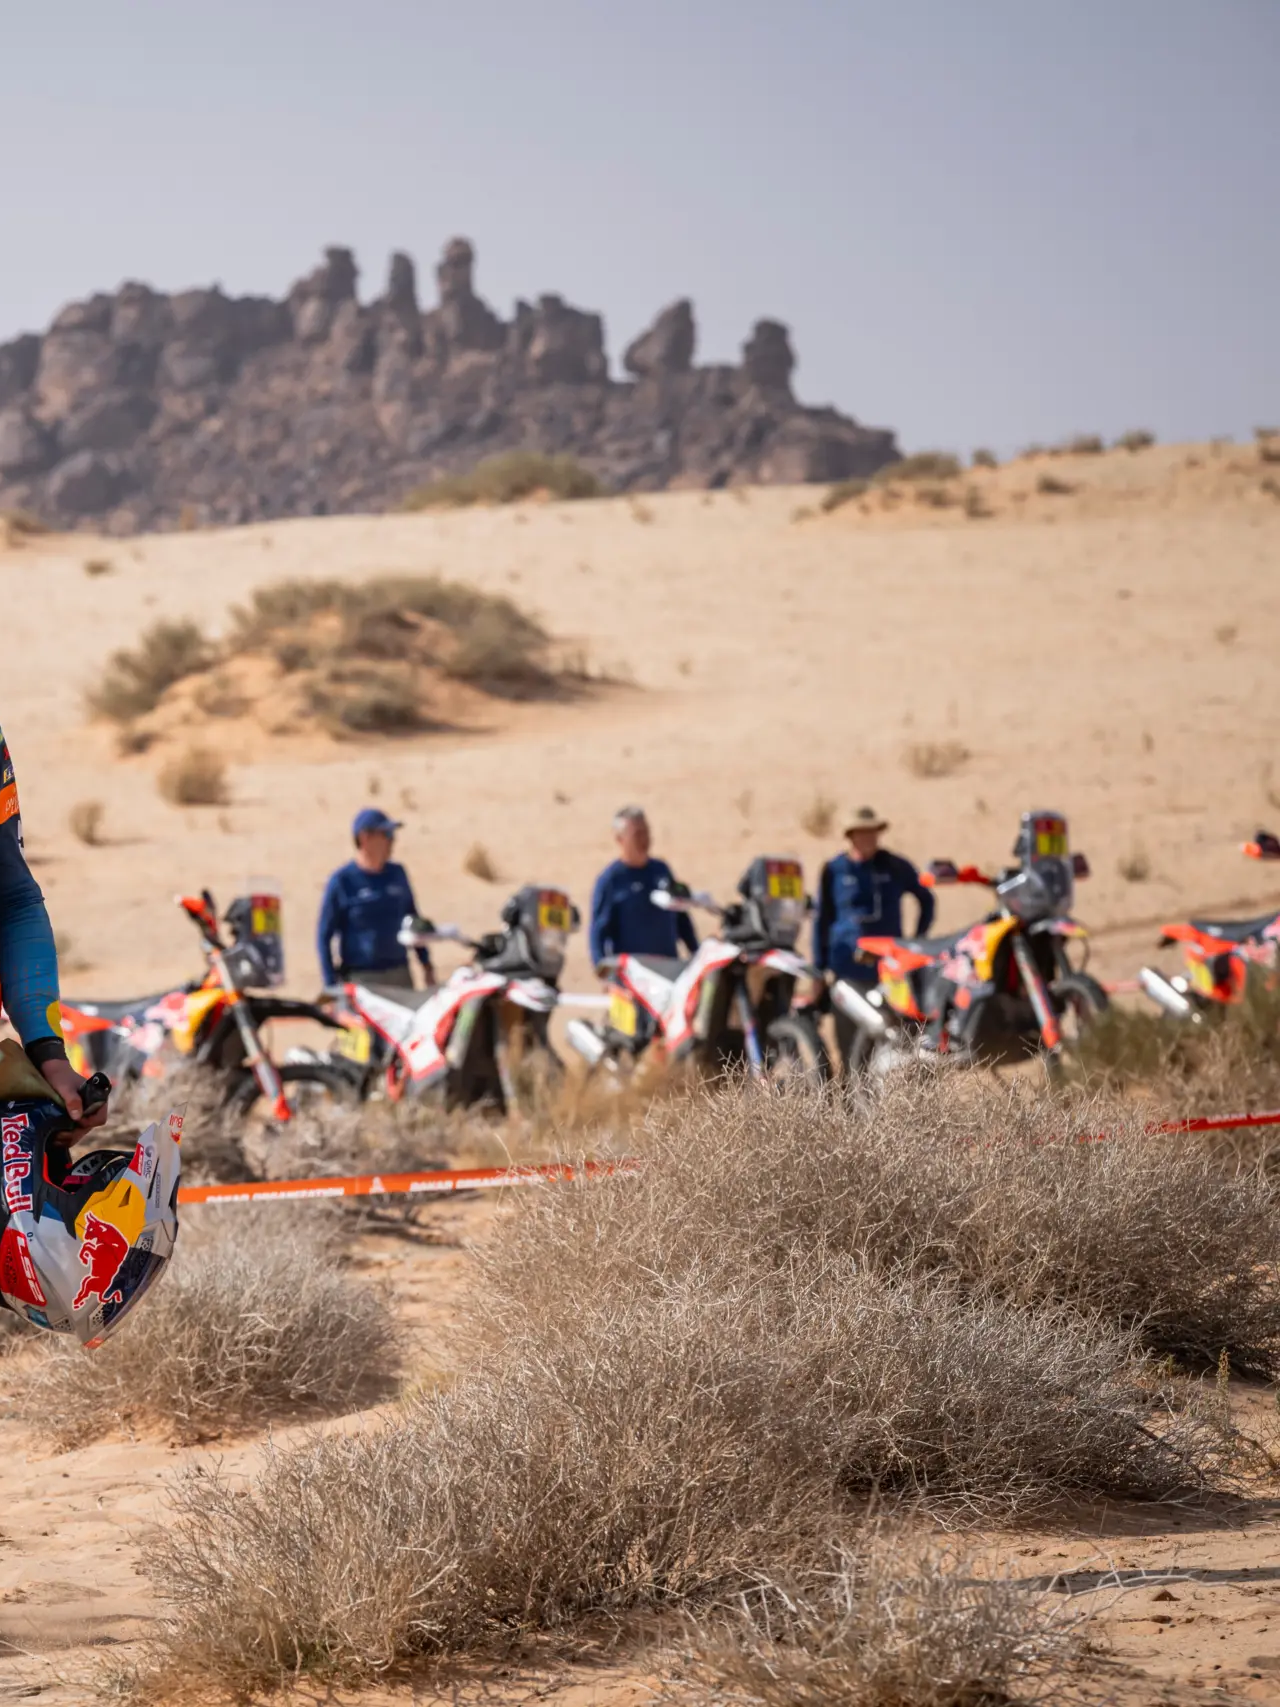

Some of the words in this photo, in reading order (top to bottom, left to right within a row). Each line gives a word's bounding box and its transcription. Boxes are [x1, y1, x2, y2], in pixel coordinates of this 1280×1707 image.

[1, 1113, 32, 1163] Red
[4, 1161, 34, 1214] Bull
[17, 1235, 45, 1303] LS2
